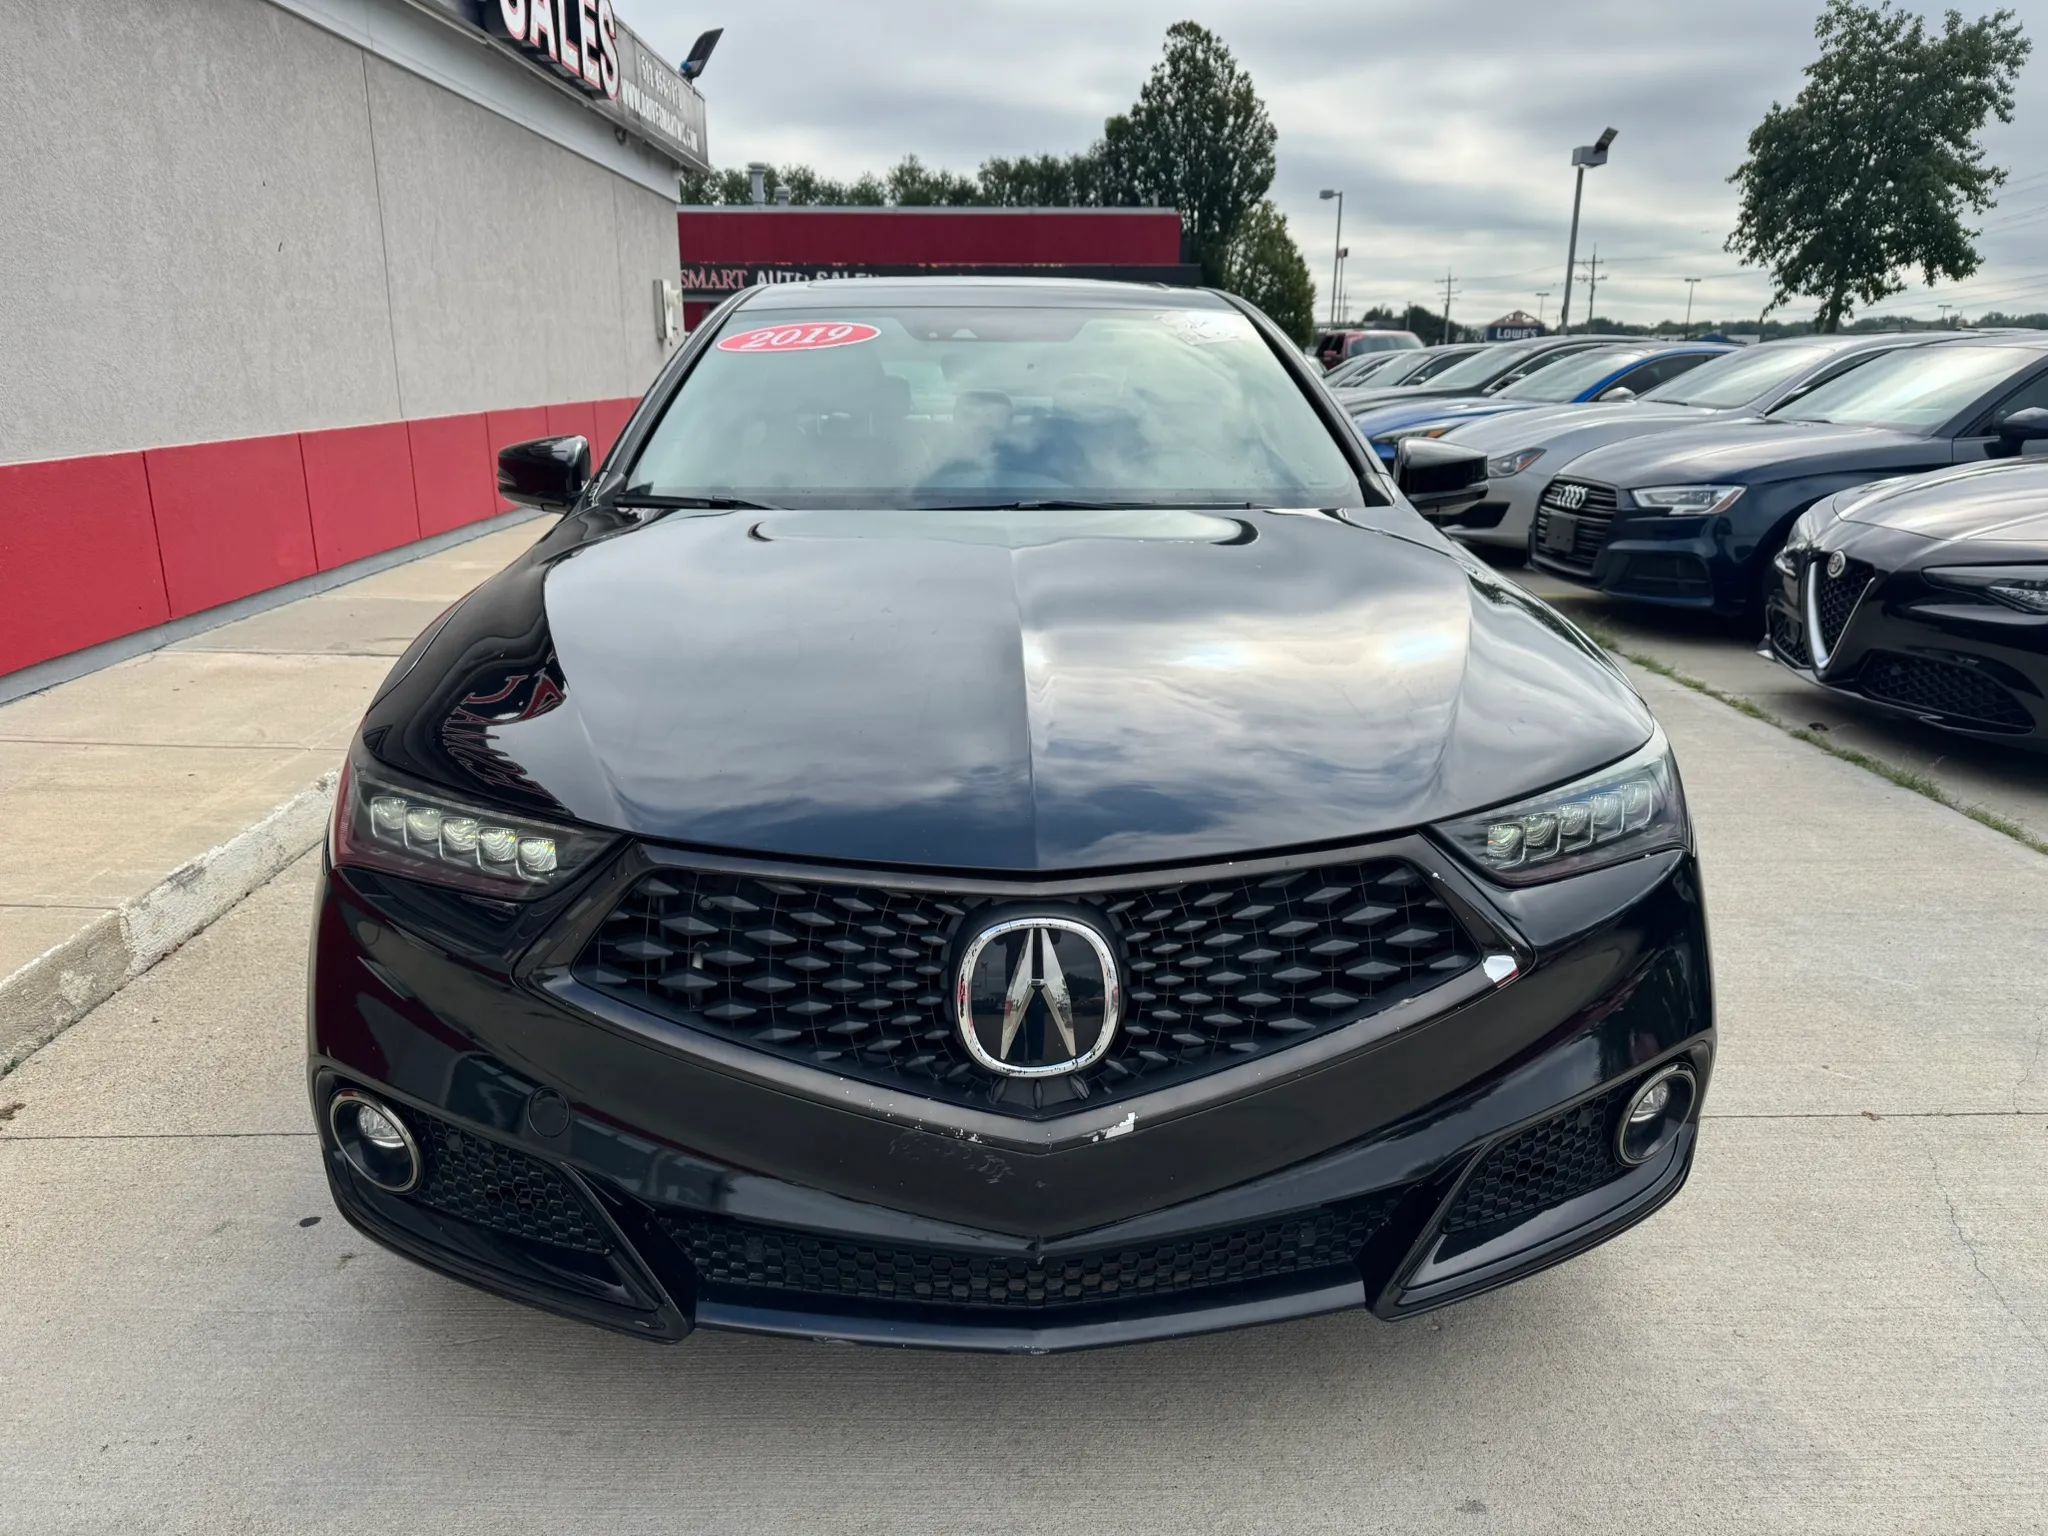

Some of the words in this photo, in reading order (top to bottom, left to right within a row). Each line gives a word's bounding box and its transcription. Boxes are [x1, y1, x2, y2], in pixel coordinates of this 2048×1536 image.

[681, 266, 748, 289] SMART
[740, 325, 854, 350] 2019
[1496, 327, 1537, 340] LOWE'S
